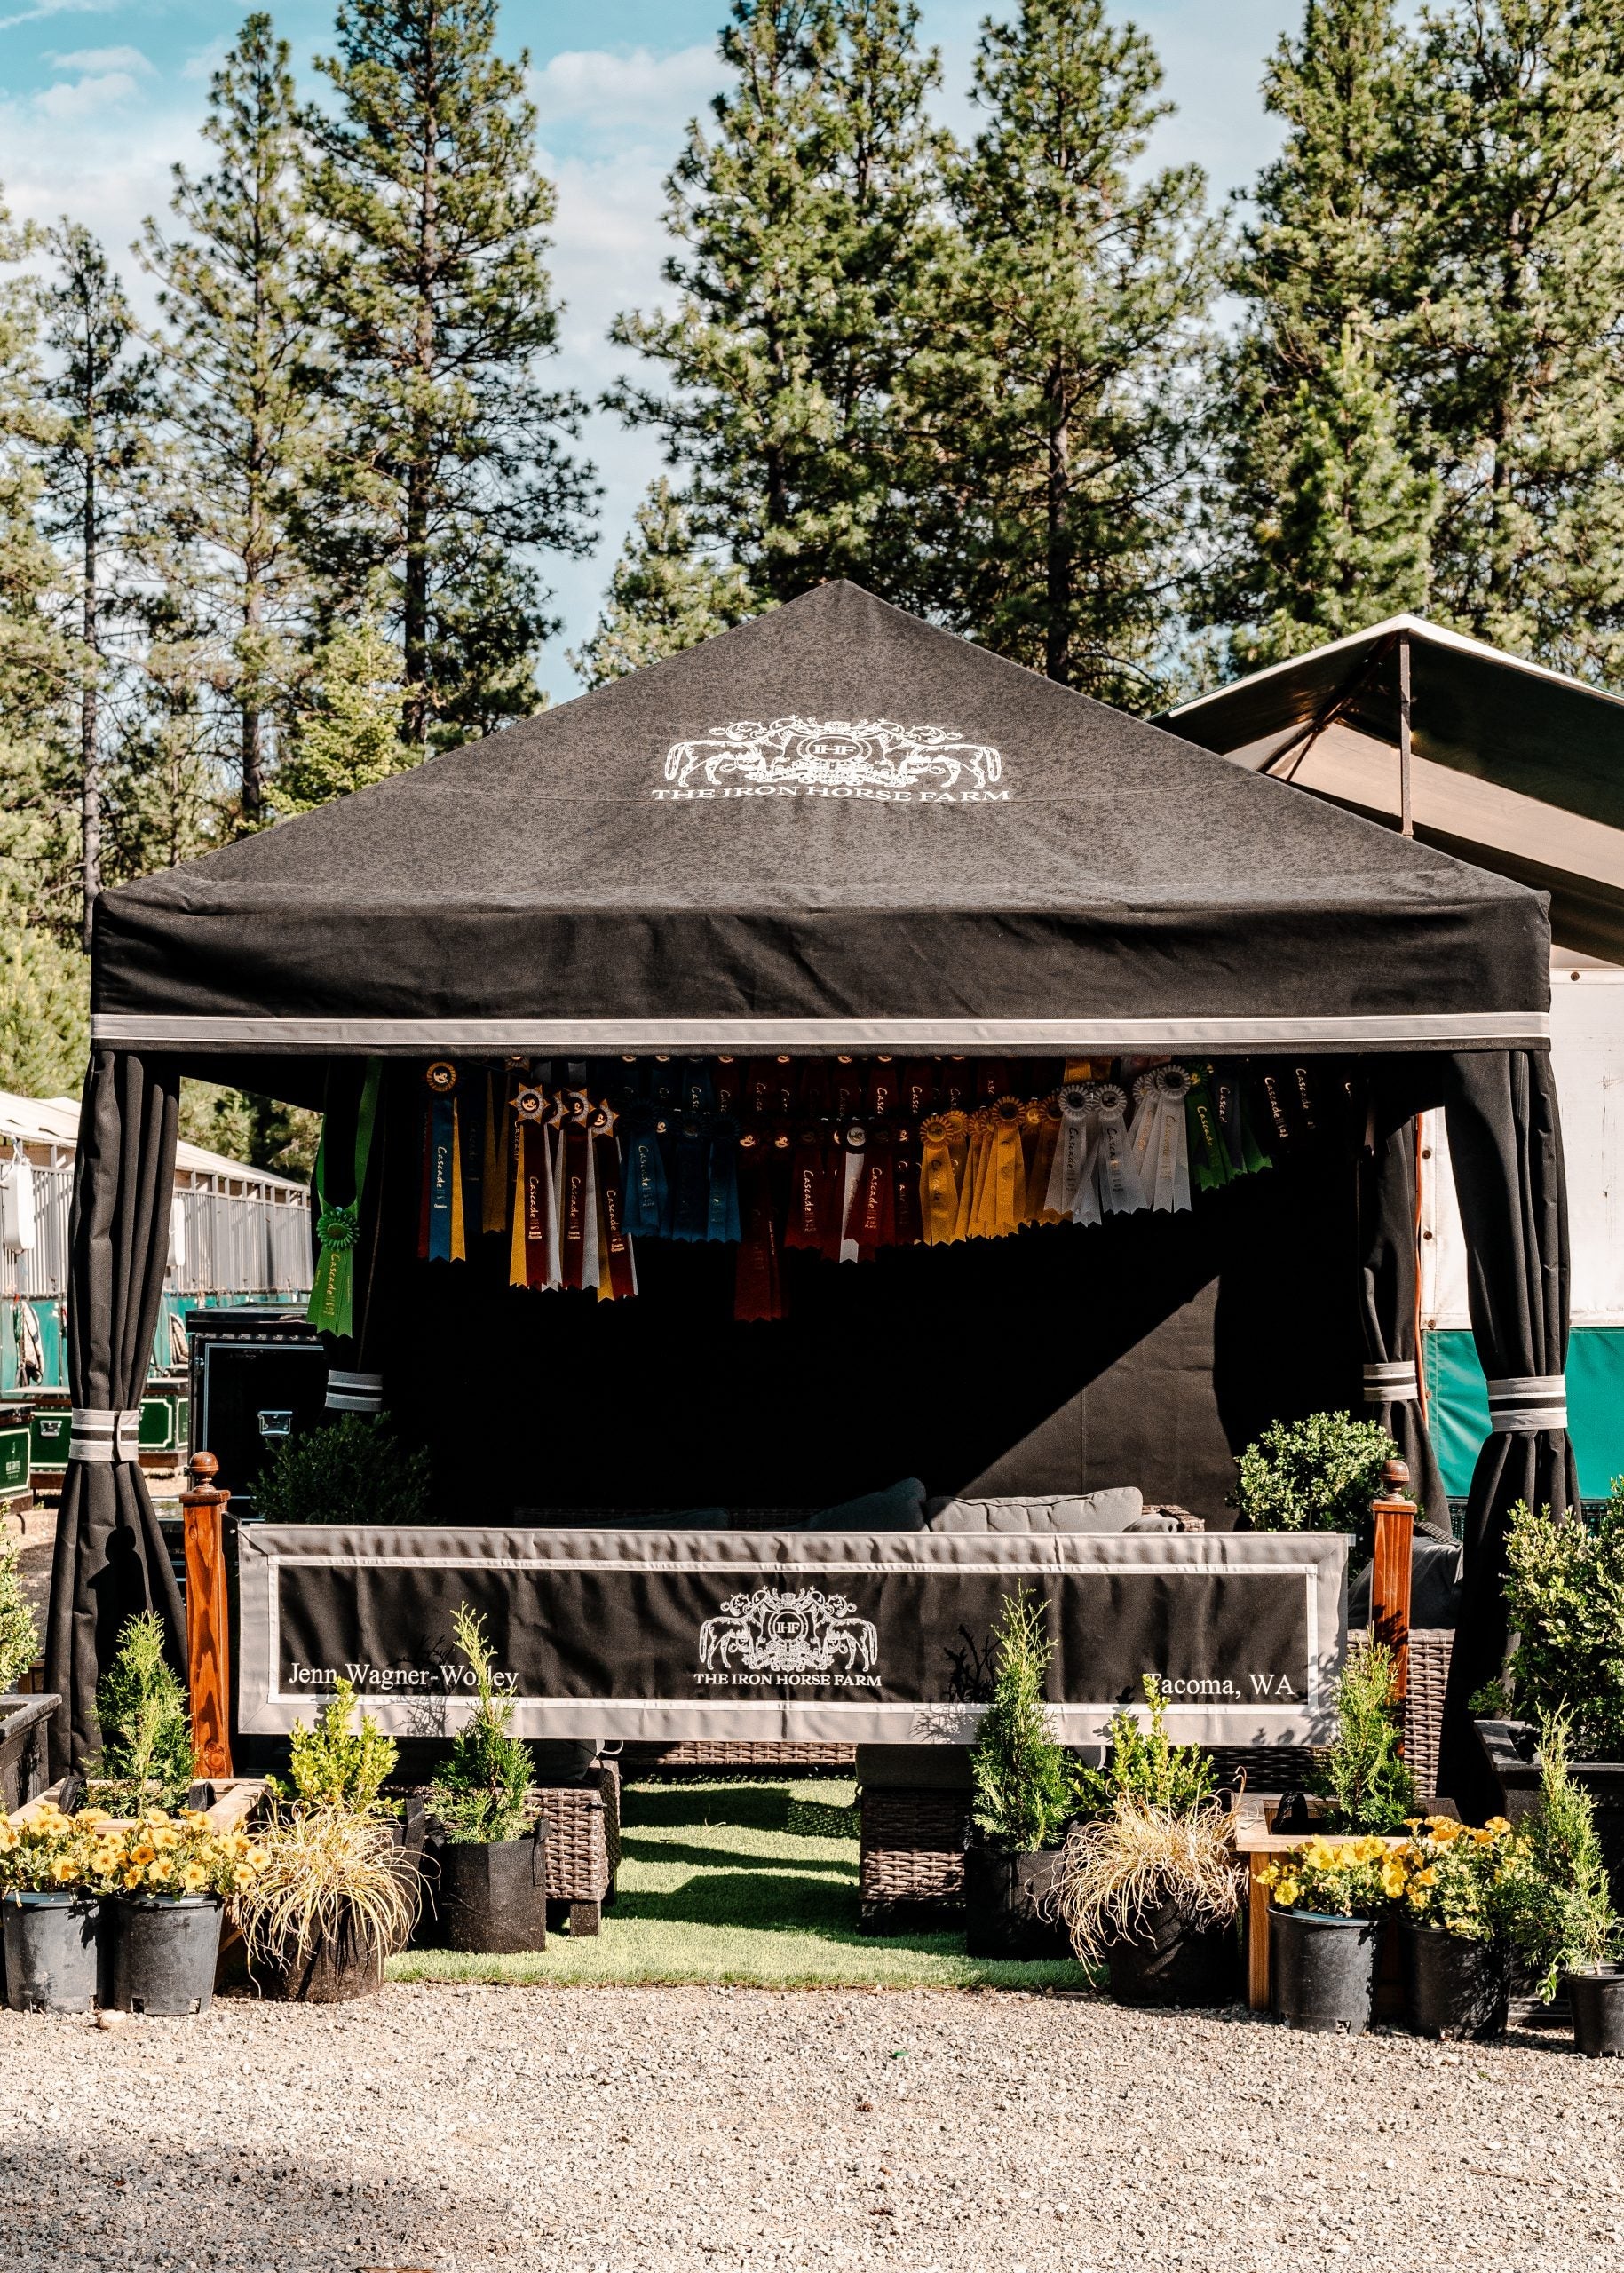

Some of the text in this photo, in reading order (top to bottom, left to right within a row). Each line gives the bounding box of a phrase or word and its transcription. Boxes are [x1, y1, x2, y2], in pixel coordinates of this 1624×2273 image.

[652, 786, 1010, 802] THE IRON HORSE FARM
[1264, 1076, 1283, 1119] Cascade
[1197, 1105, 1215, 1147] Cascade
[436, 1145, 448, 1189] Cascade
[1067, 1127, 1079, 1170] Cascade
[529, 1176, 540, 1218] Cascade
[571, 1176, 582, 1218] Cascade
[803, 1169, 815, 1212] Cascade
[868, 1166, 883, 1208] Cascade
[606, 1189, 620, 1232] Cascade
[326, 1253, 341, 1295] Cascade
[289, 1662, 519, 1692] Jenn Wagner-Woley
[693, 1673, 883, 1687] THE IRON HORSE FARM
[1248, 1674, 1296, 1695] WA
